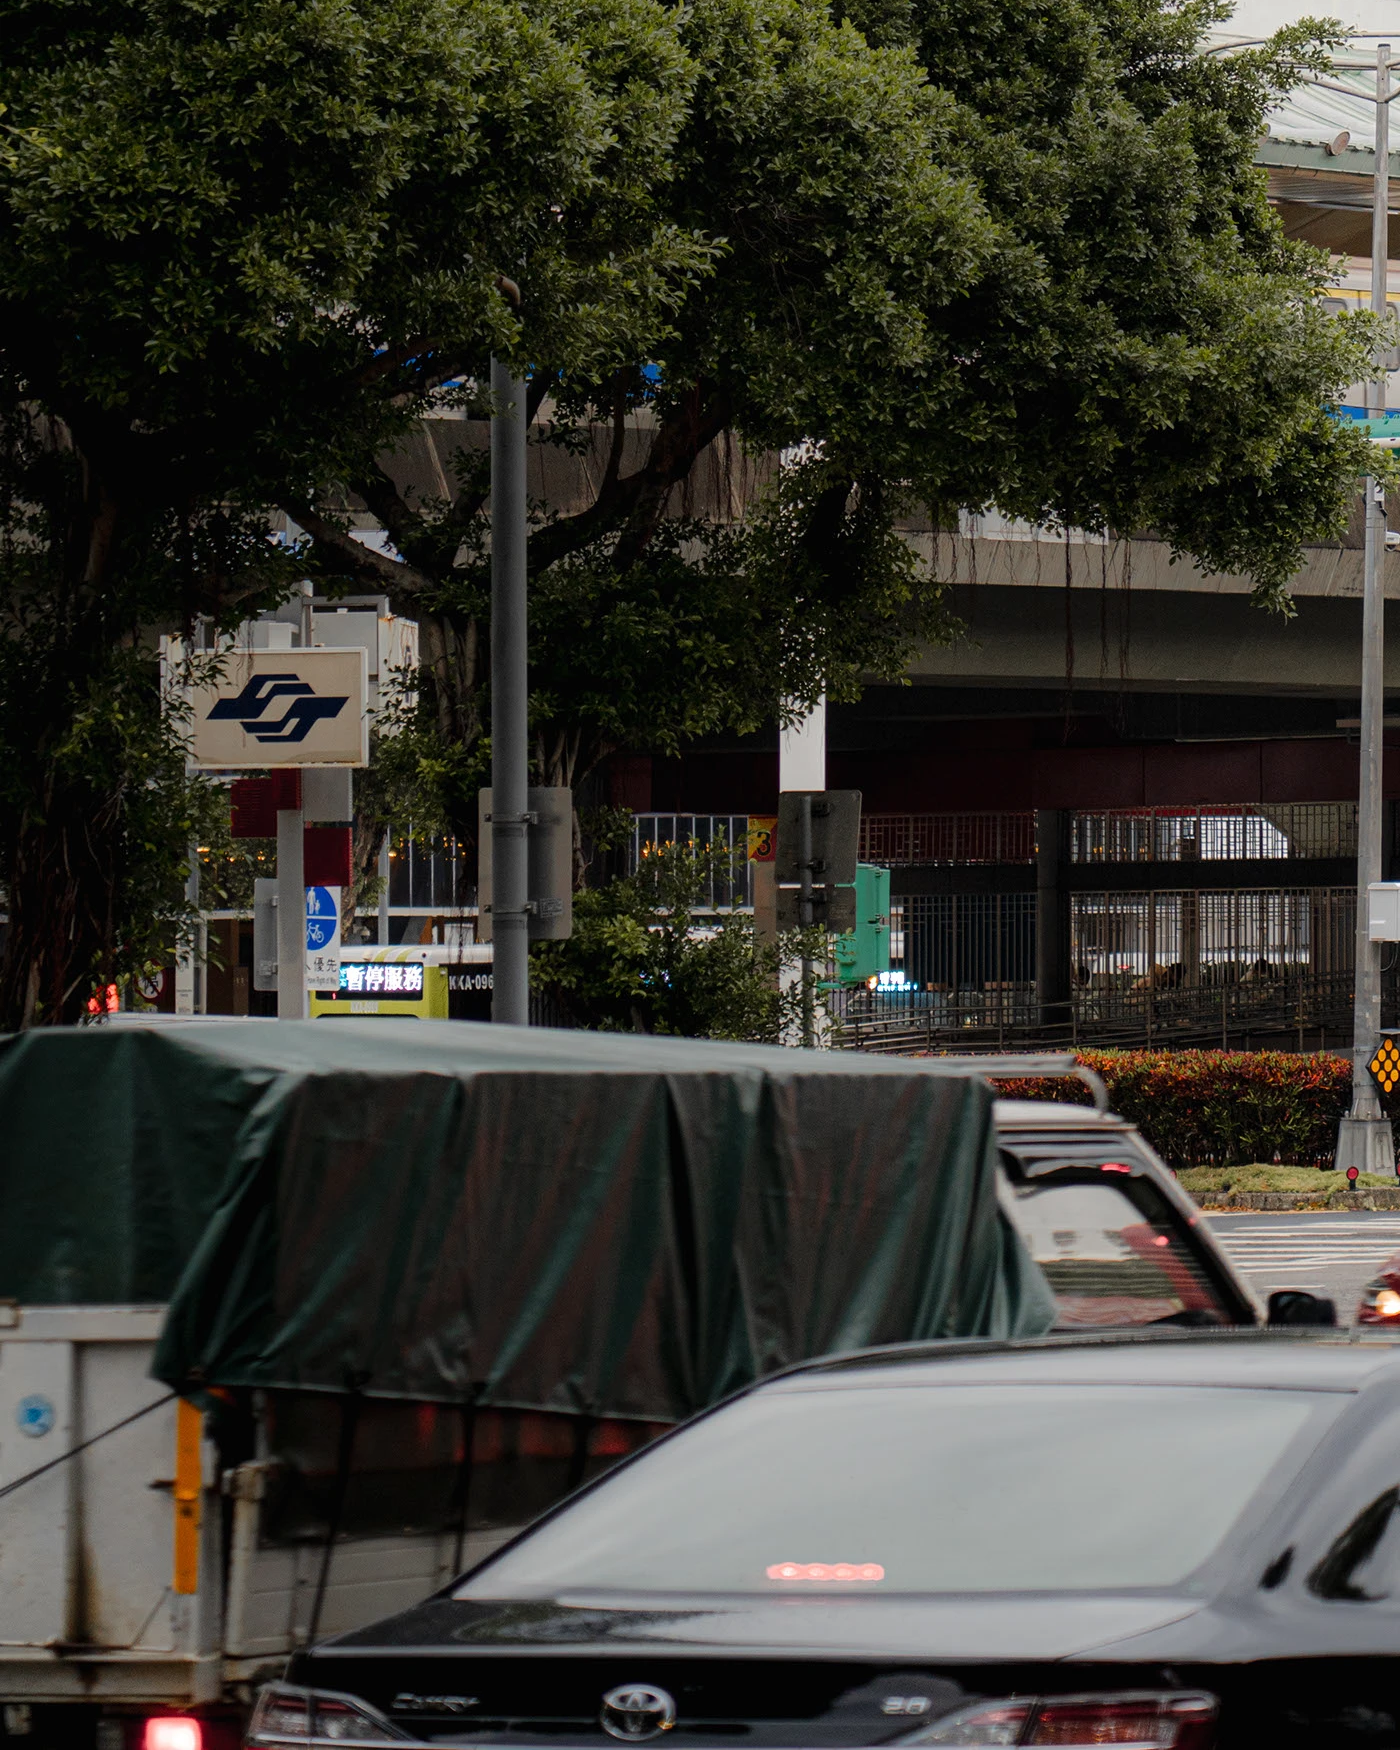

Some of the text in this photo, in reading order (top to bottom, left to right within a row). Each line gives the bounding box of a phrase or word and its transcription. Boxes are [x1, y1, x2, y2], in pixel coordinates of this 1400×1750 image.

[757, 831, 771, 856] 3
[305, 956, 338, 973] 優先
[346, 964, 423, 992] 暫停服務
